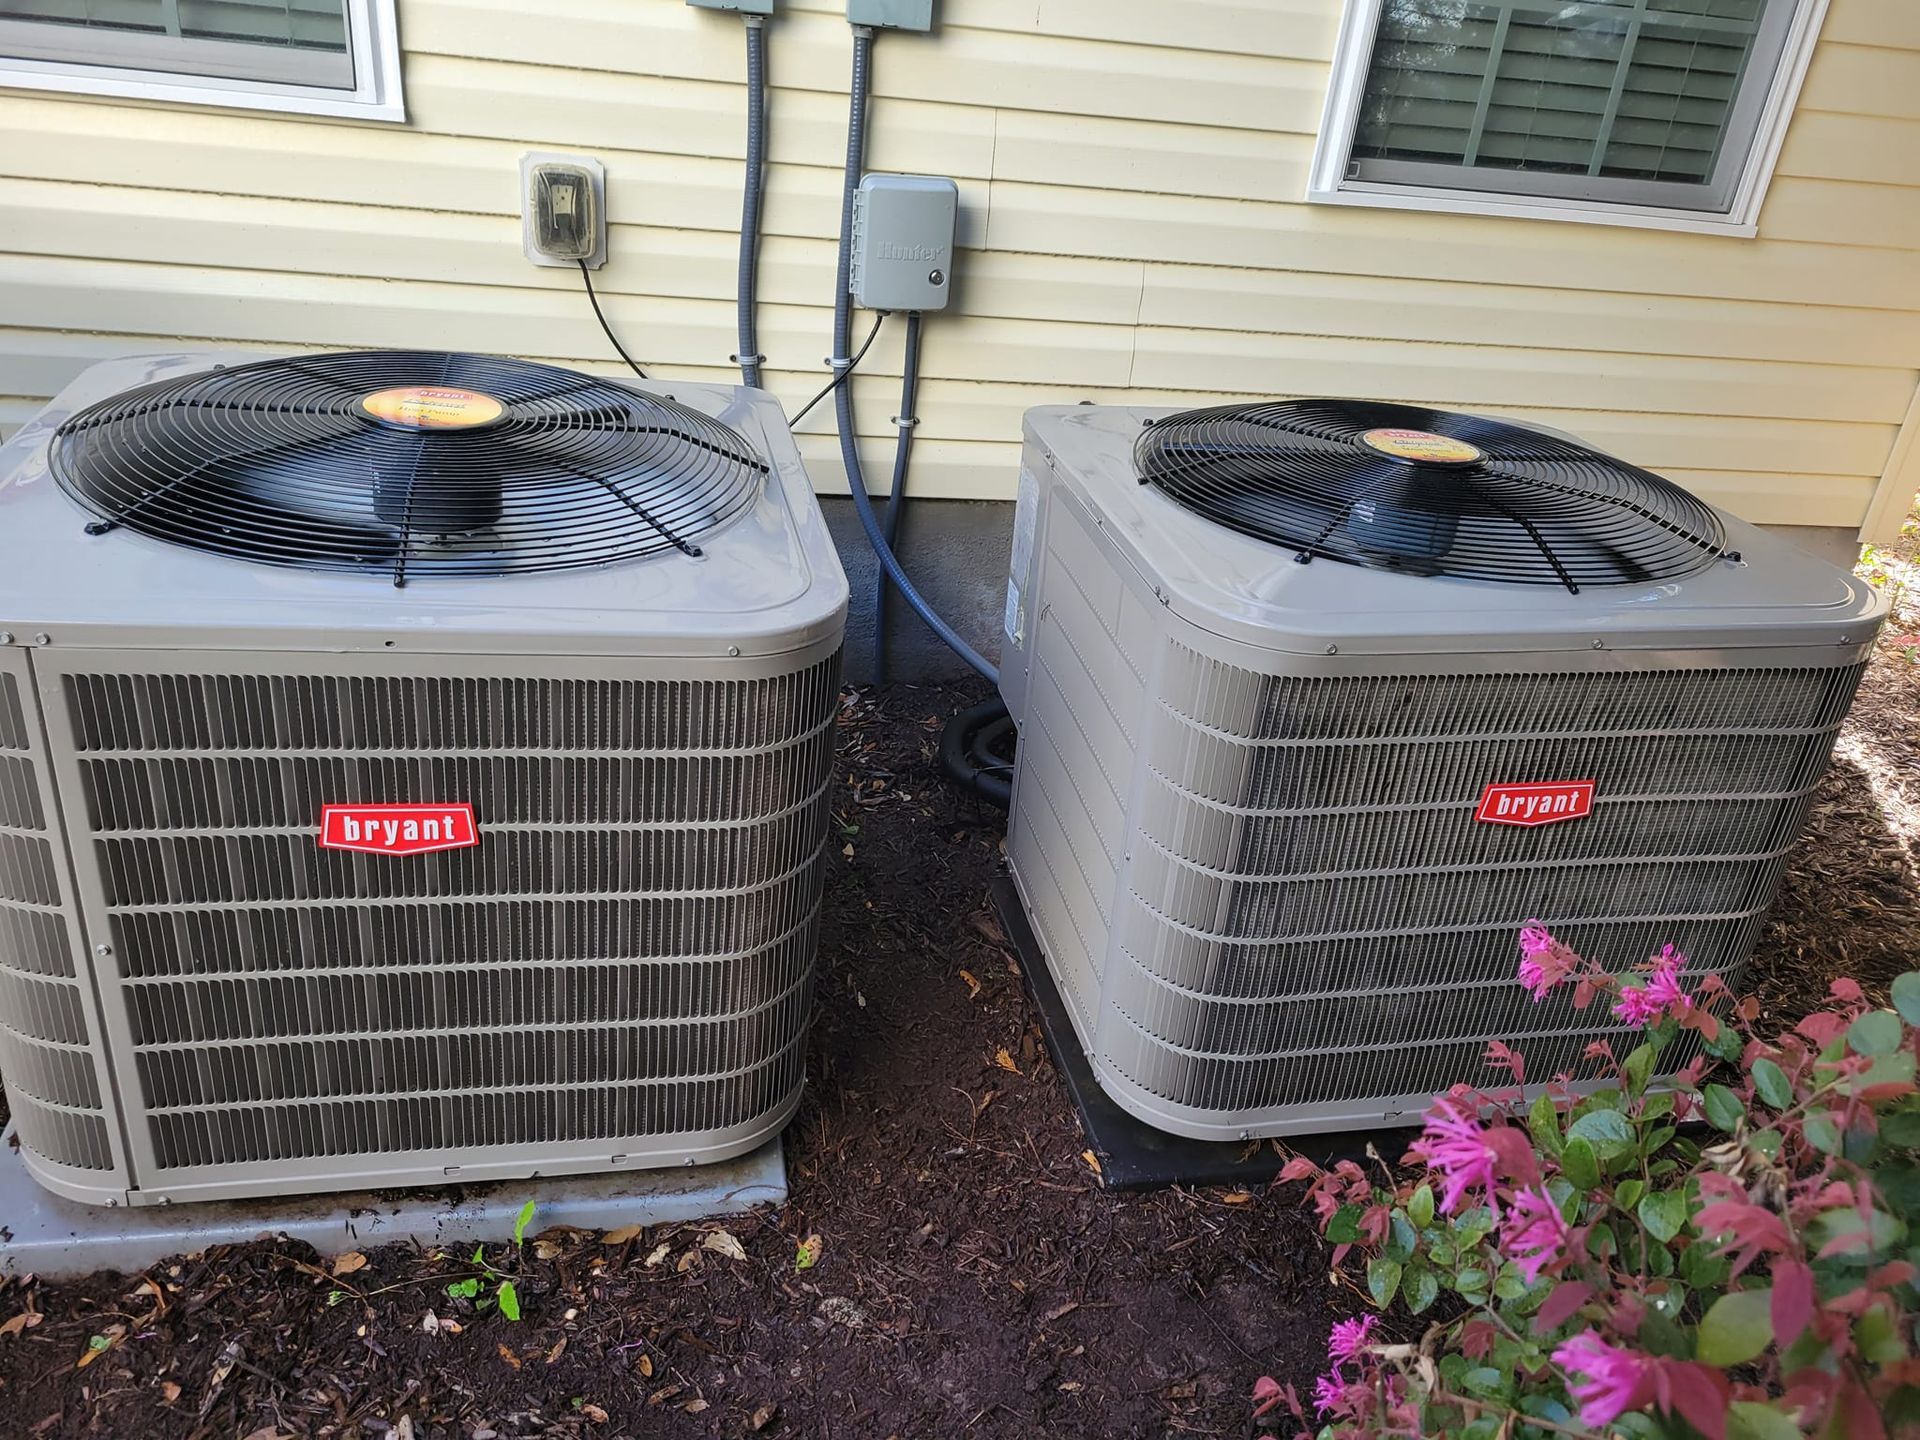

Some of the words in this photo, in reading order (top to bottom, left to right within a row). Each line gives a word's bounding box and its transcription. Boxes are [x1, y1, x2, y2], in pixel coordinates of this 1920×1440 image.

[877, 240, 944, 261] Hunter
[1496, 791, 1580, 819] bryant
[343, 815, 455, 846] bryant
